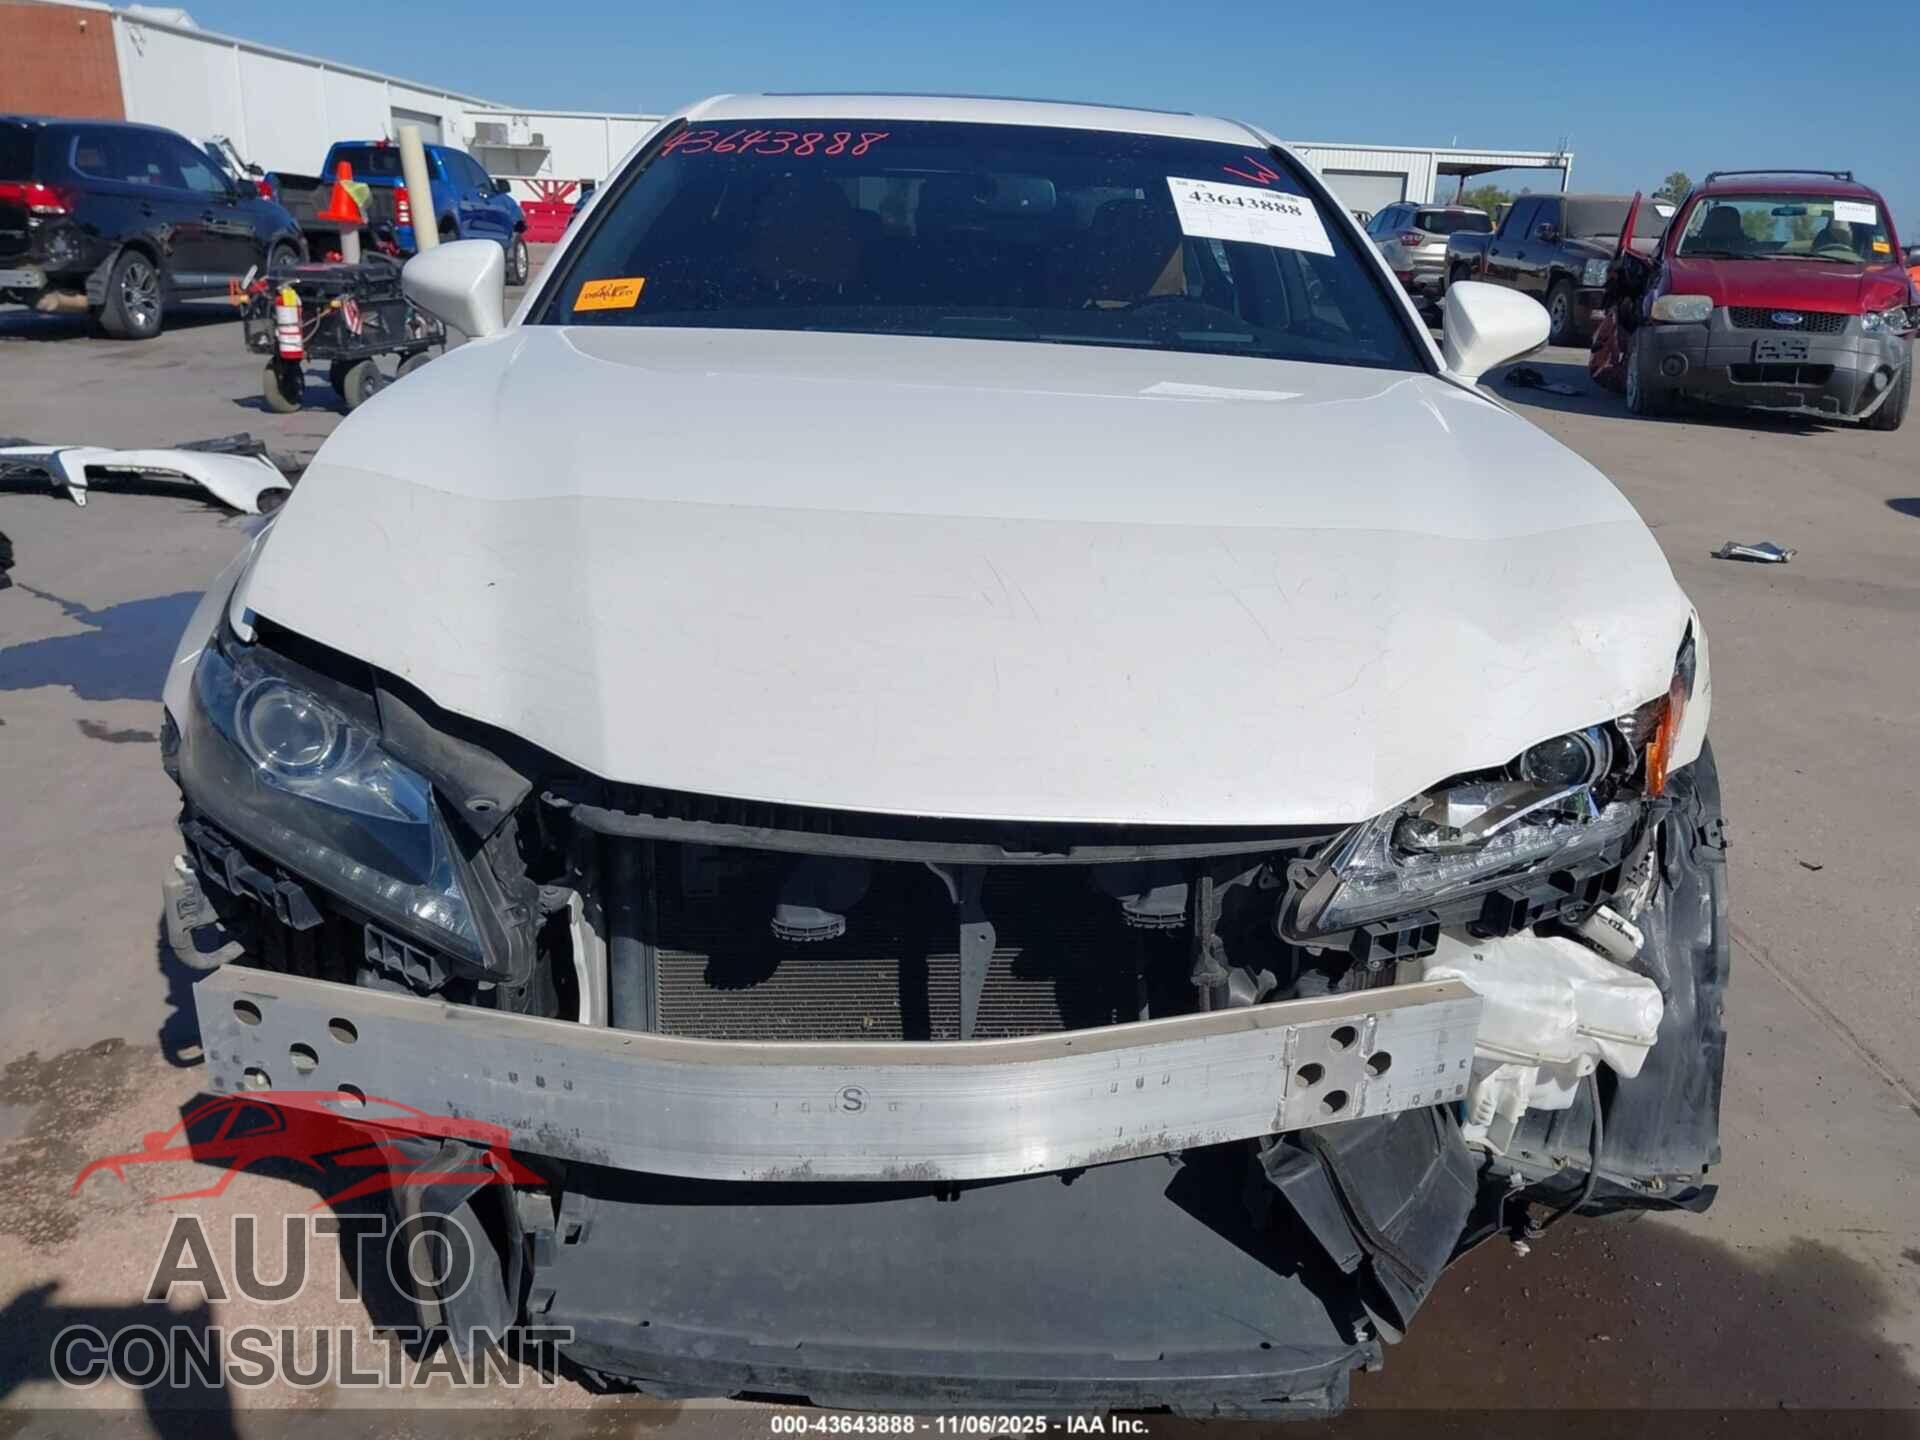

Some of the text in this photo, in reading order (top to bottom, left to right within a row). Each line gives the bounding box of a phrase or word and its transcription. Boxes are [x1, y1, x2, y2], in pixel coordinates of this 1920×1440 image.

[660, 129, 890, 157] 43643888
[1188, 190, 1303, 216] 43643888
[841, 1088, 863, 1111] S
